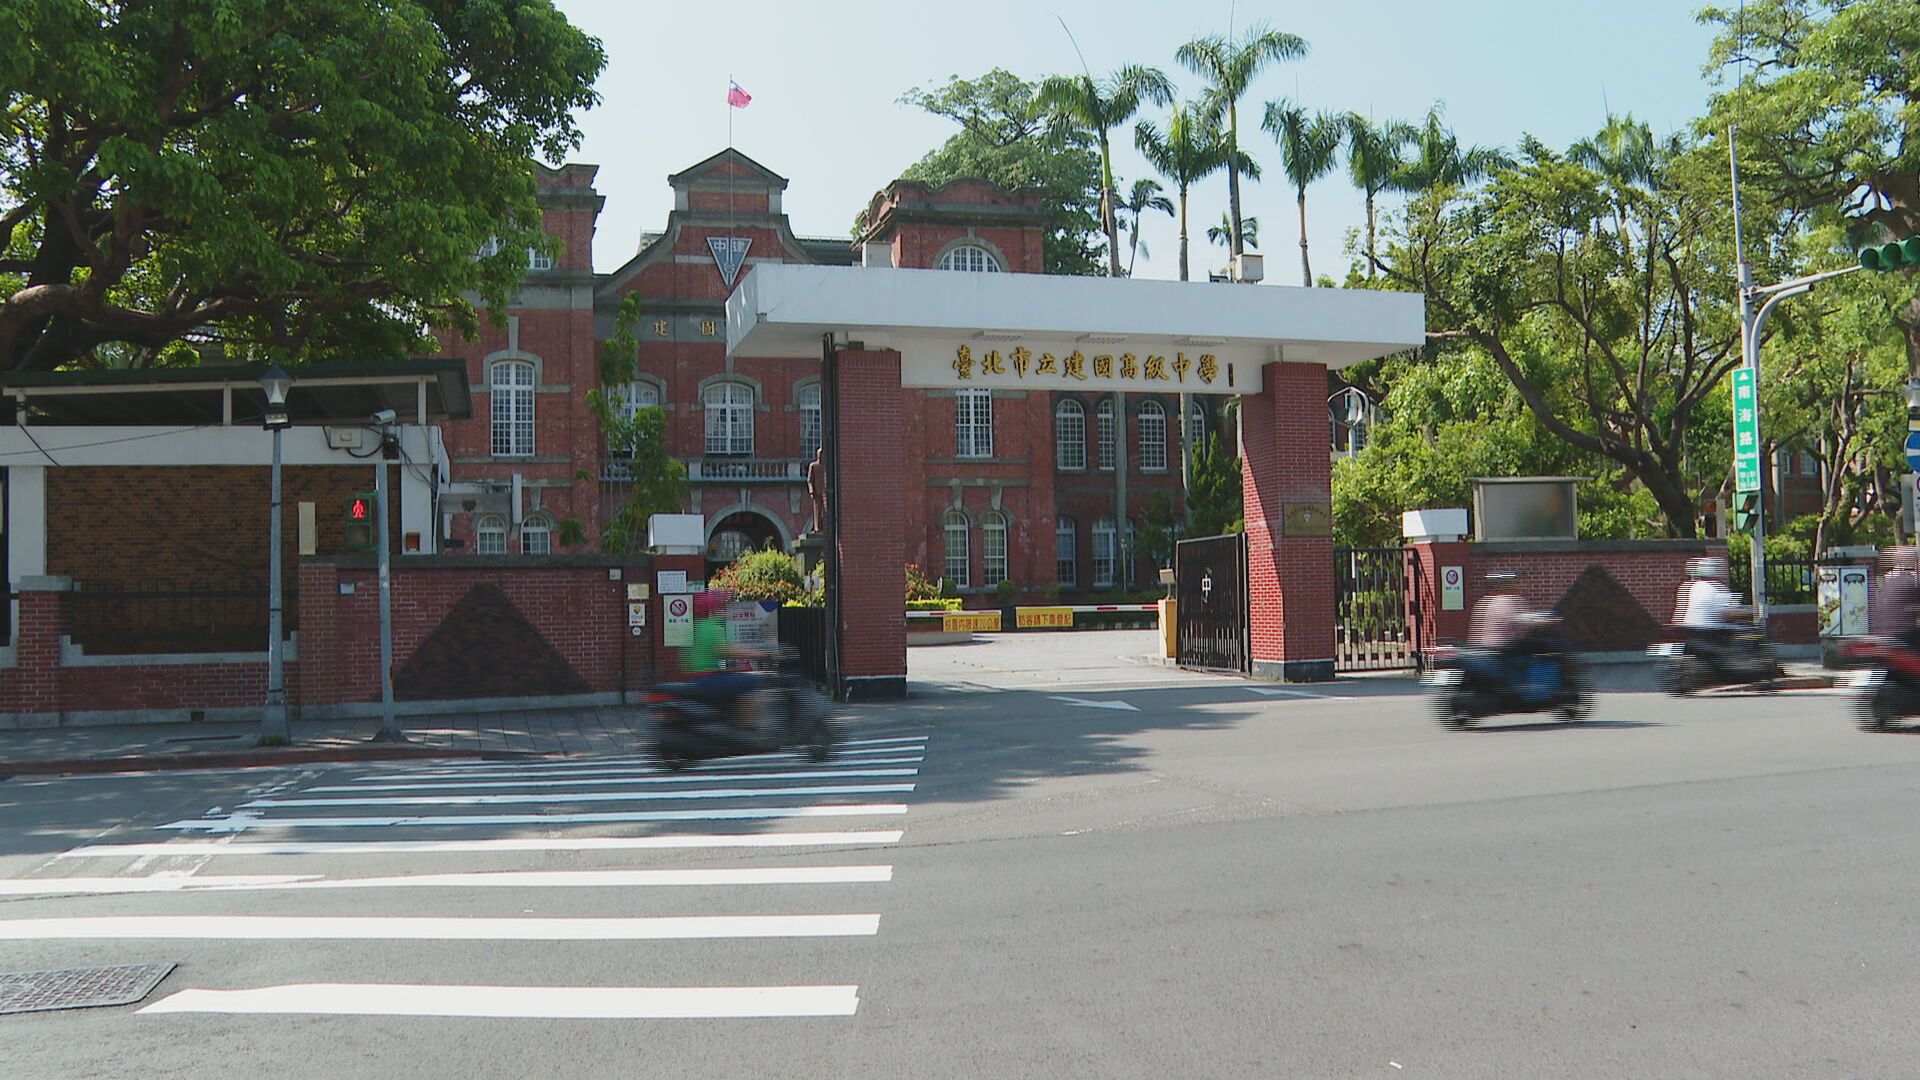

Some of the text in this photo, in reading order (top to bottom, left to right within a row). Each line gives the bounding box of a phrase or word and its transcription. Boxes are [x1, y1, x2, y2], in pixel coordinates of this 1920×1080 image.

[952, 344, 1219, 385] 臺北市立建國高級中學
[1738, 385, 1753, 446] 南海路
